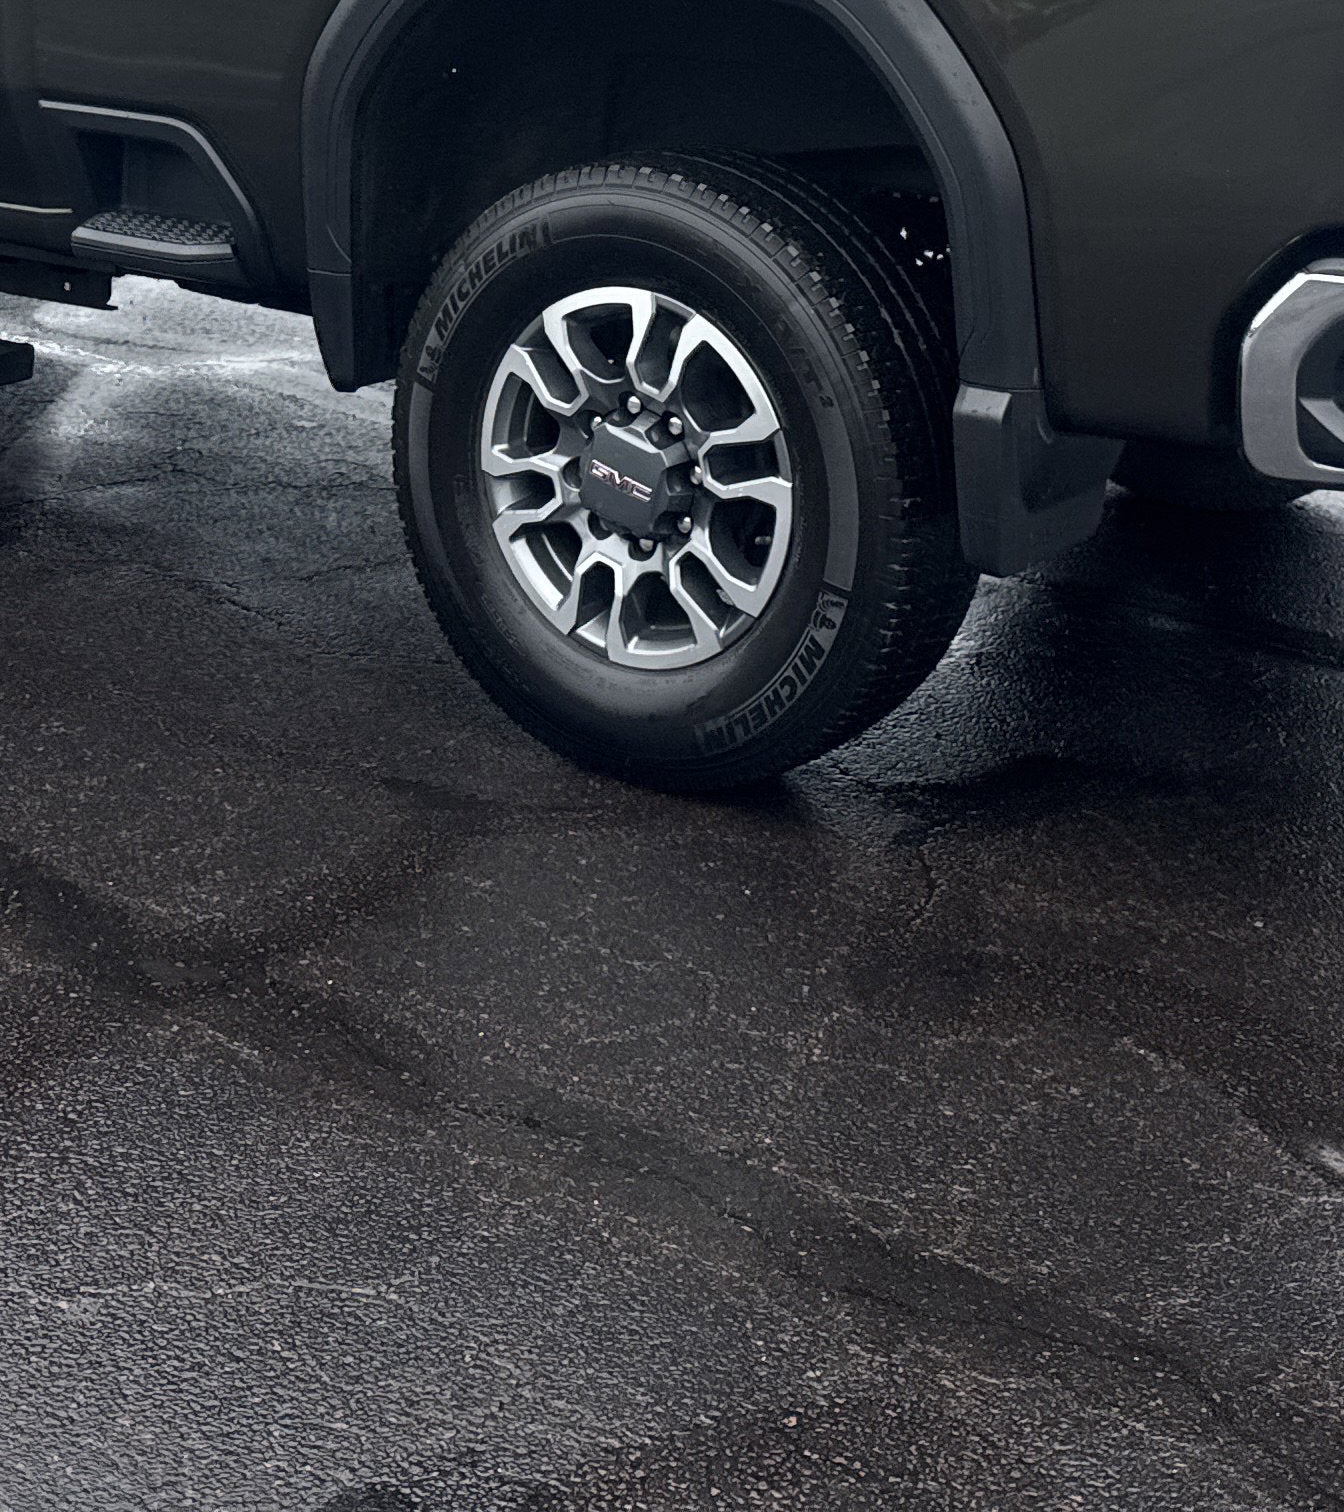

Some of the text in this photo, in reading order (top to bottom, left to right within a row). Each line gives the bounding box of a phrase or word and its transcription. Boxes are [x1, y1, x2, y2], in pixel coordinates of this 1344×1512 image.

[434, 222, 540, 342] MICHELIN
[590, 459, 654, 503] GMC
[704, 634, 826, 752] MICHELIN
